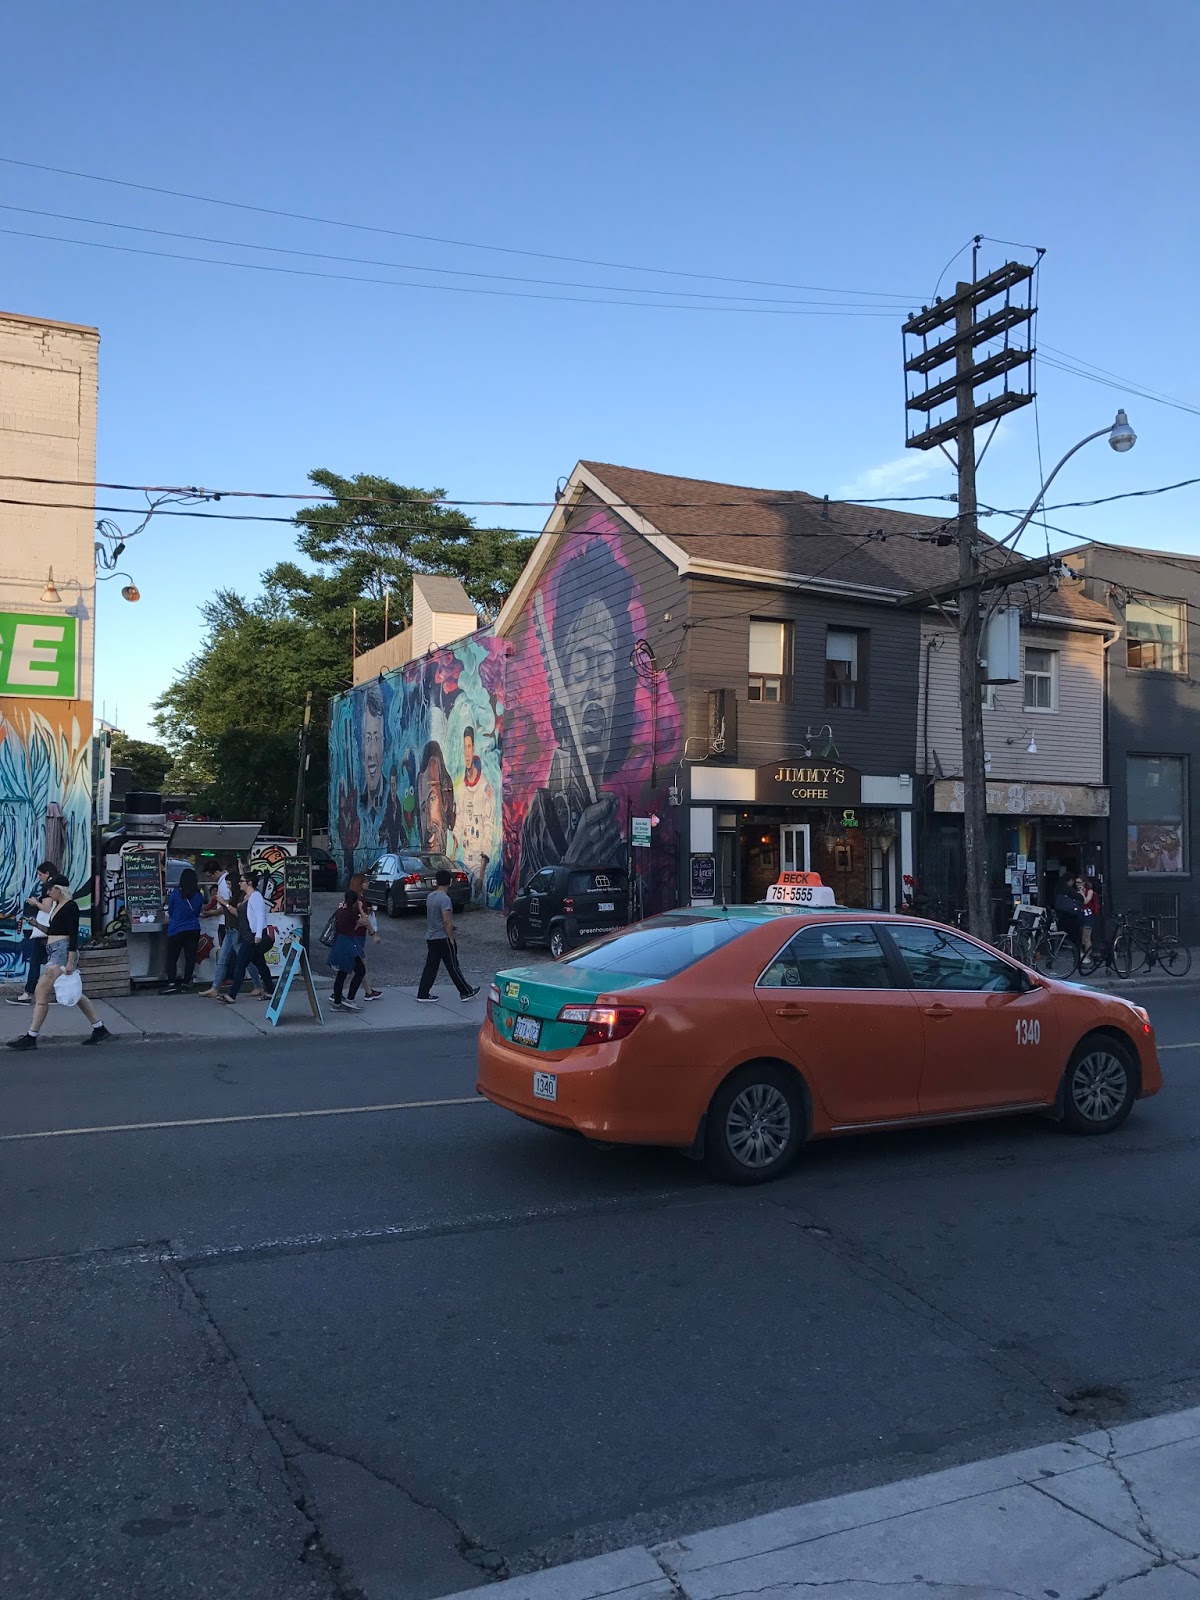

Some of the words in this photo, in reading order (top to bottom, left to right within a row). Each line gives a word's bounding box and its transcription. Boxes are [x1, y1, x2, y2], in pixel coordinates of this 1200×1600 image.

[0, 624, 65, 686] E
[774, 767, 846, 784] JIMMY'S
[791, 788, 829, 799] COFFEE
[783, 874, 809, 884] BECK
[772, 887, 813, 901] 751-5555
[1015, 1019, 1041, 1045] 1340
[536, 1078, 554, 1095] 1340
